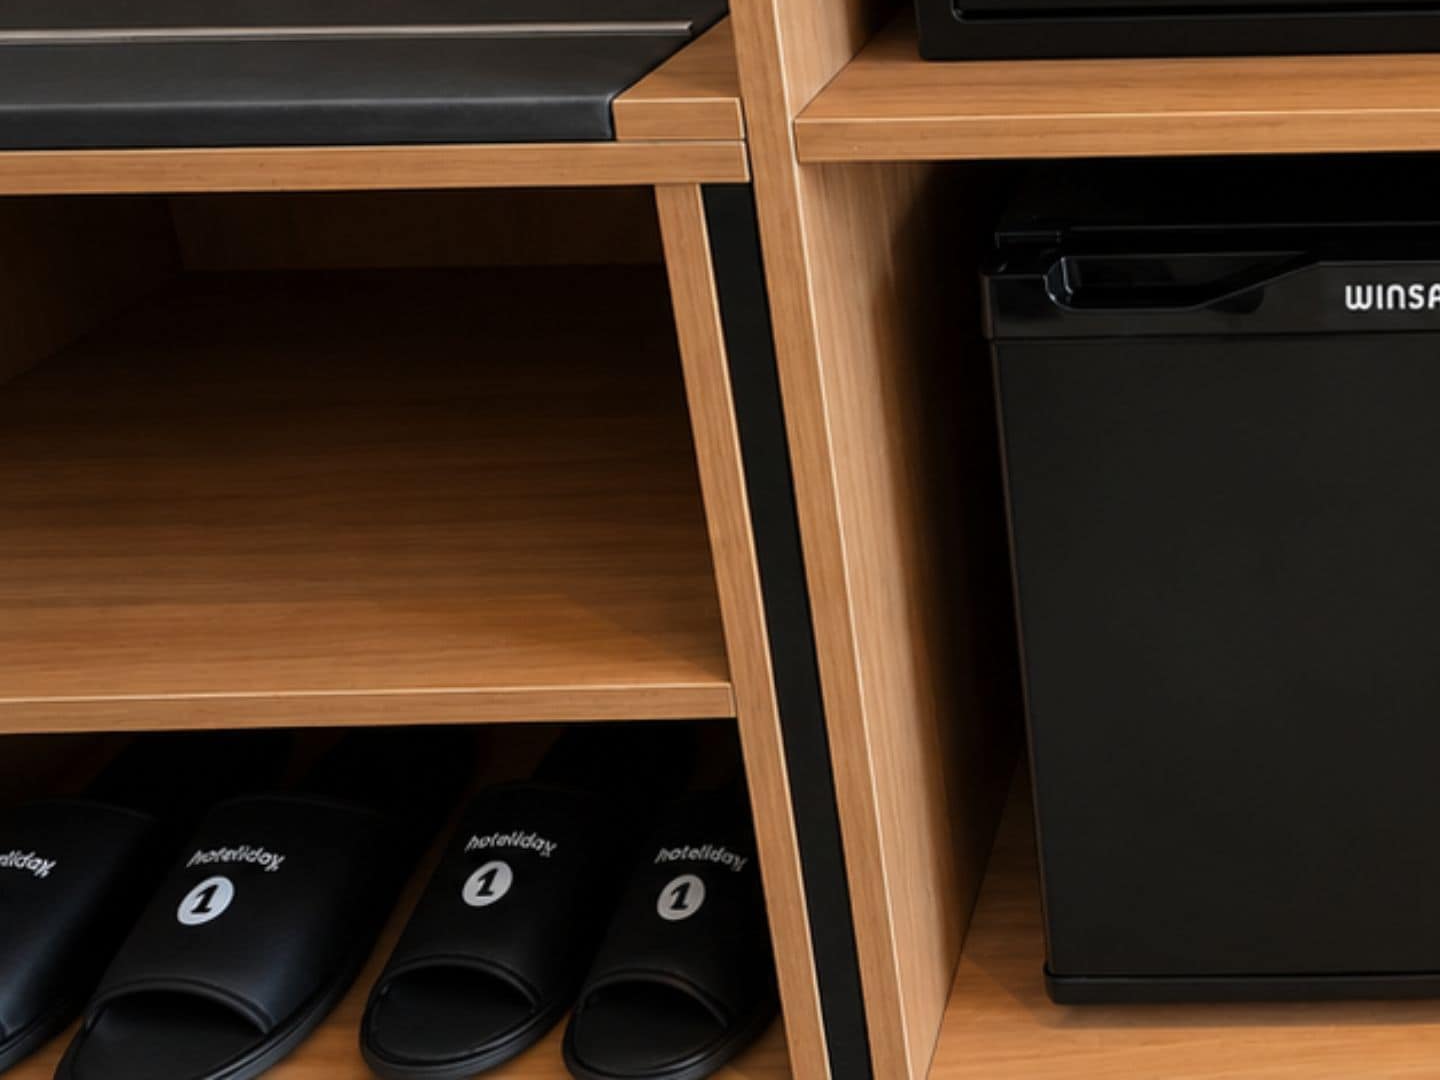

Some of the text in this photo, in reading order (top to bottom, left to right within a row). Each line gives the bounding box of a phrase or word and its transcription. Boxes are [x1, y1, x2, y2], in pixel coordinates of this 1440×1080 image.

[474, 867, 500, 898] 1
[670, 881, 692, 911] 1
[188, 883, 220, 915] 1
